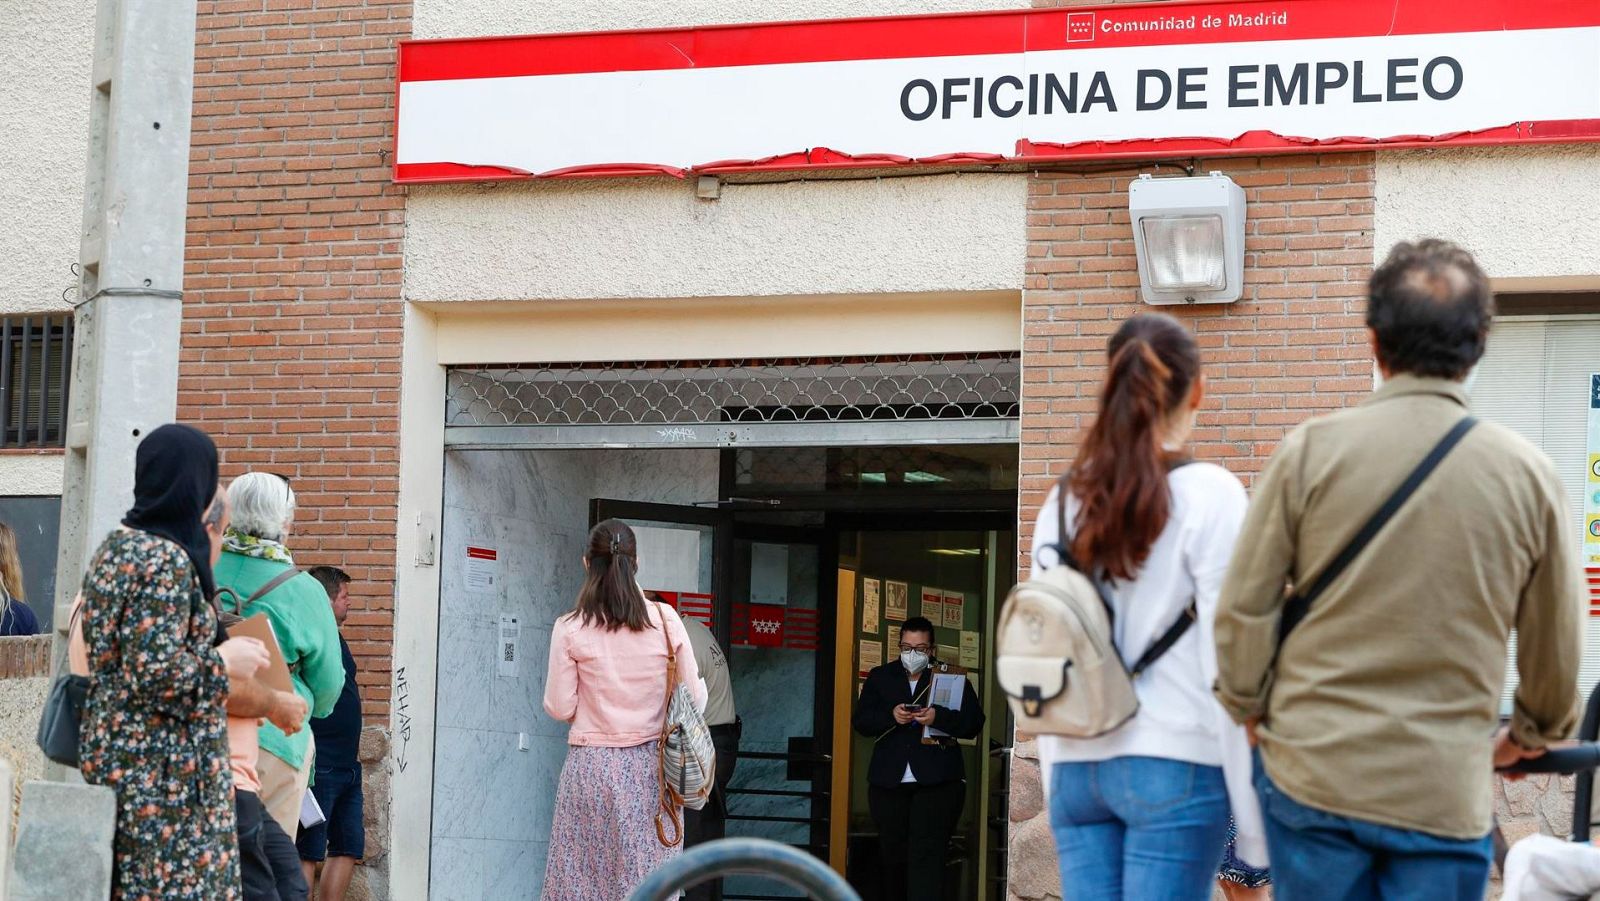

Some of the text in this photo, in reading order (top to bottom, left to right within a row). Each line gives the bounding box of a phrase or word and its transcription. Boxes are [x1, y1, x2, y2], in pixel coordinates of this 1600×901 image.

[1101, 12, 1286, 32] Comunidad de Madrid
[900, 56, 1463, 121] OFICINA DE EMPLEO
